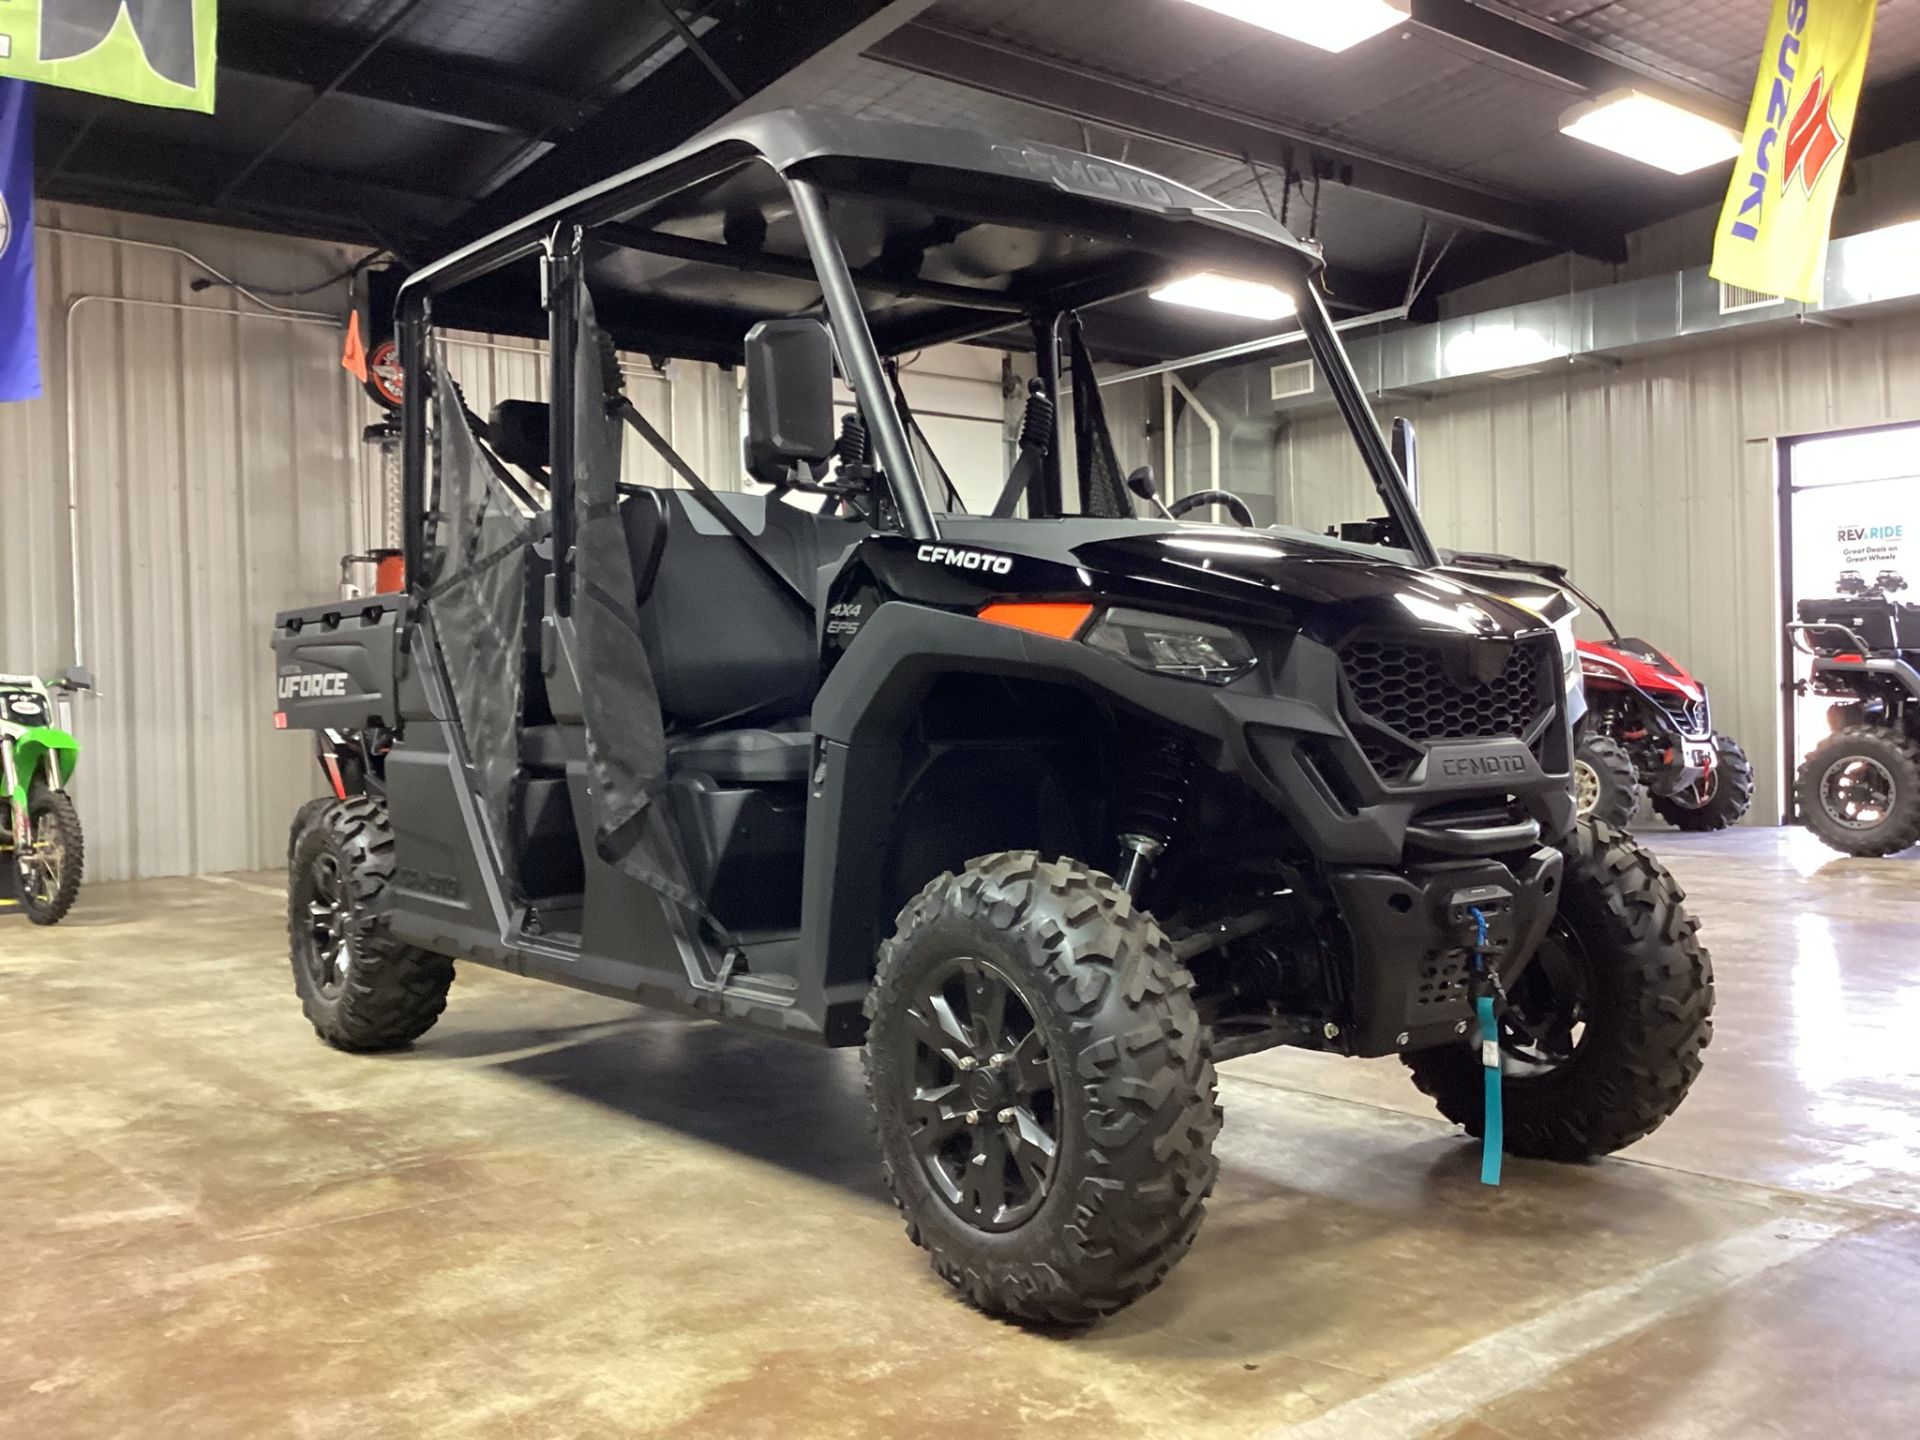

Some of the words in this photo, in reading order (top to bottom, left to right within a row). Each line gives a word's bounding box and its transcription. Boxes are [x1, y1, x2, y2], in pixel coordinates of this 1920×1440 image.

[1731, 0, 1808, 241] SUZUKI
[1843, 547, 1865, 555] Great
[1866, 546, 1887, 554] Deals
[1845, 555, 1867, 563] Great
[1868, 554, 1896, 562] Wheels
[917, 545, 1013, 575] CFMOTO
[830, 604, 862, 617] 4X4
[827, 621, 860, 634] EPS
[279, 672, 349, 699] UFORCE
[1442, 755, 1526, 776] CFMOTO
